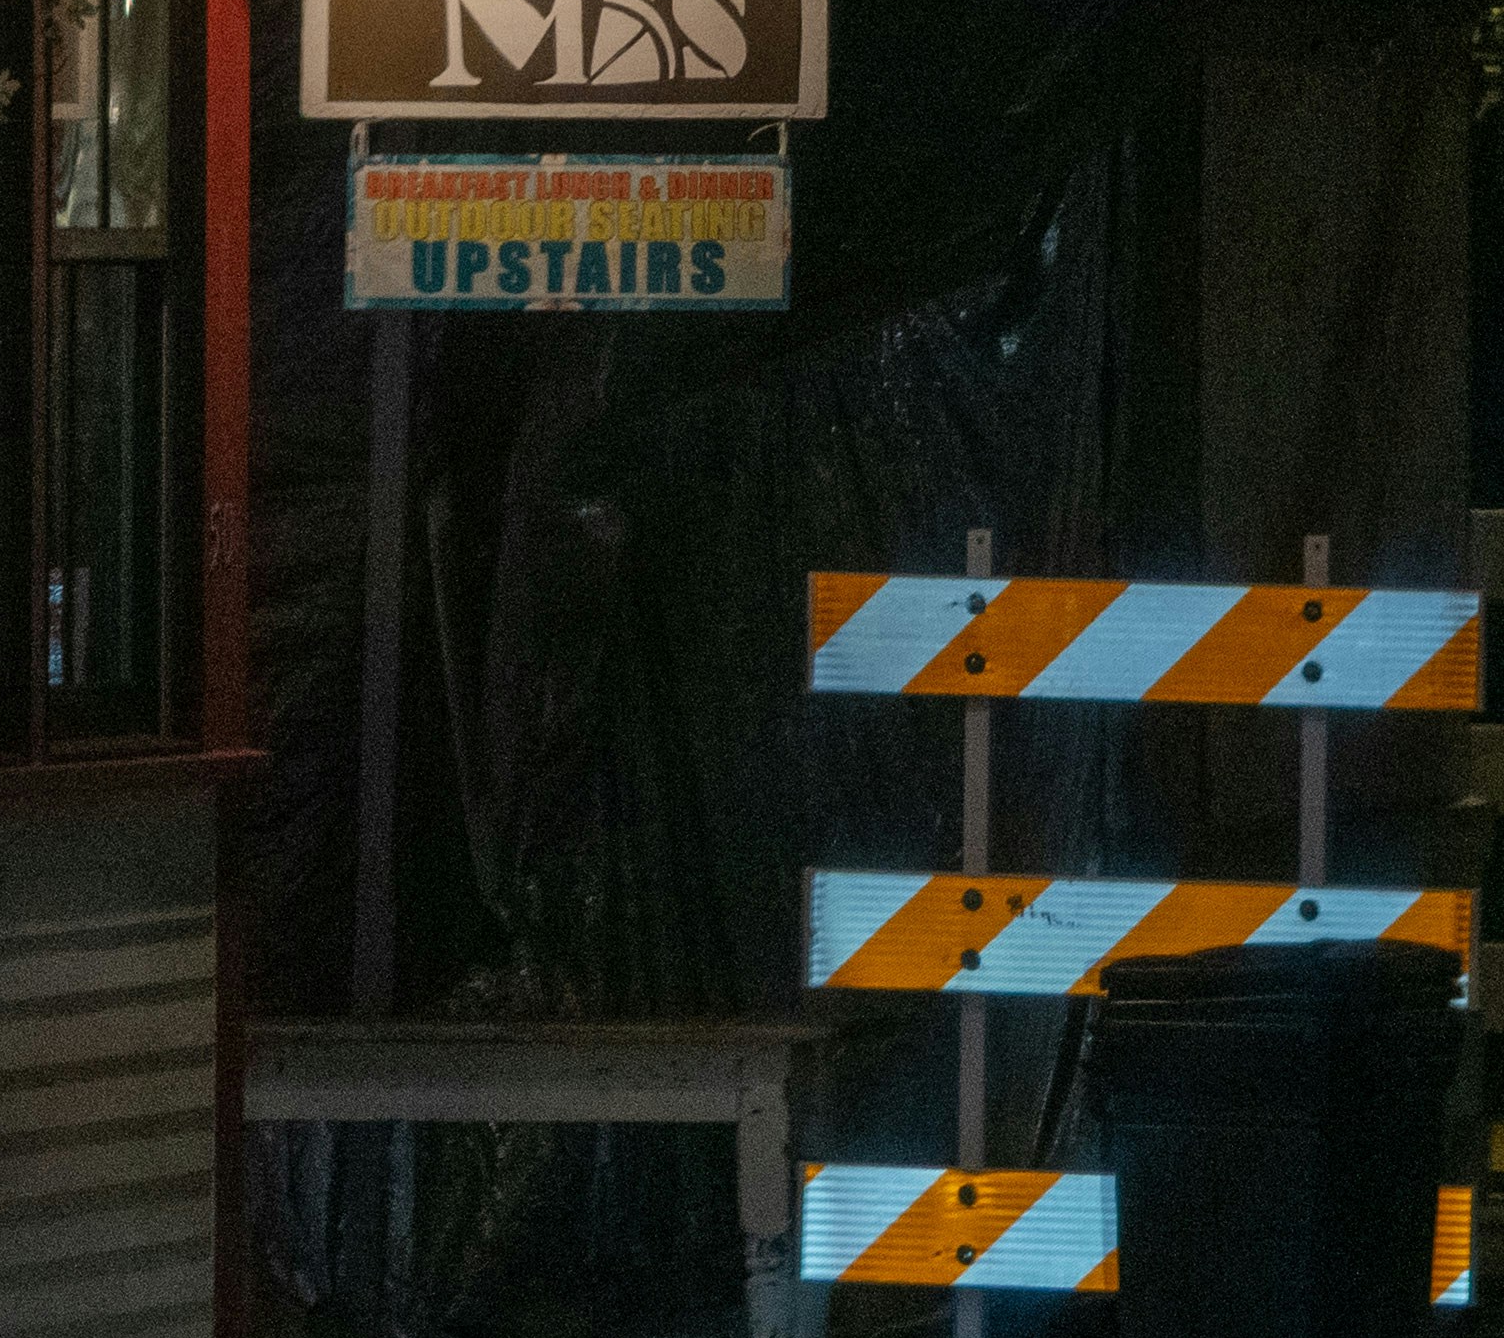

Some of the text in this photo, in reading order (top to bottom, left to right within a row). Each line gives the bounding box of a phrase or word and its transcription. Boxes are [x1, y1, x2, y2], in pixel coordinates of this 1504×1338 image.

[364, 171, 775, 201] BREAKFAST LUNCH & DINNER
[371, 199, 767, 244] OUTDOOR SEATING
[410, 239, 727, 295] UPSTAIRS
